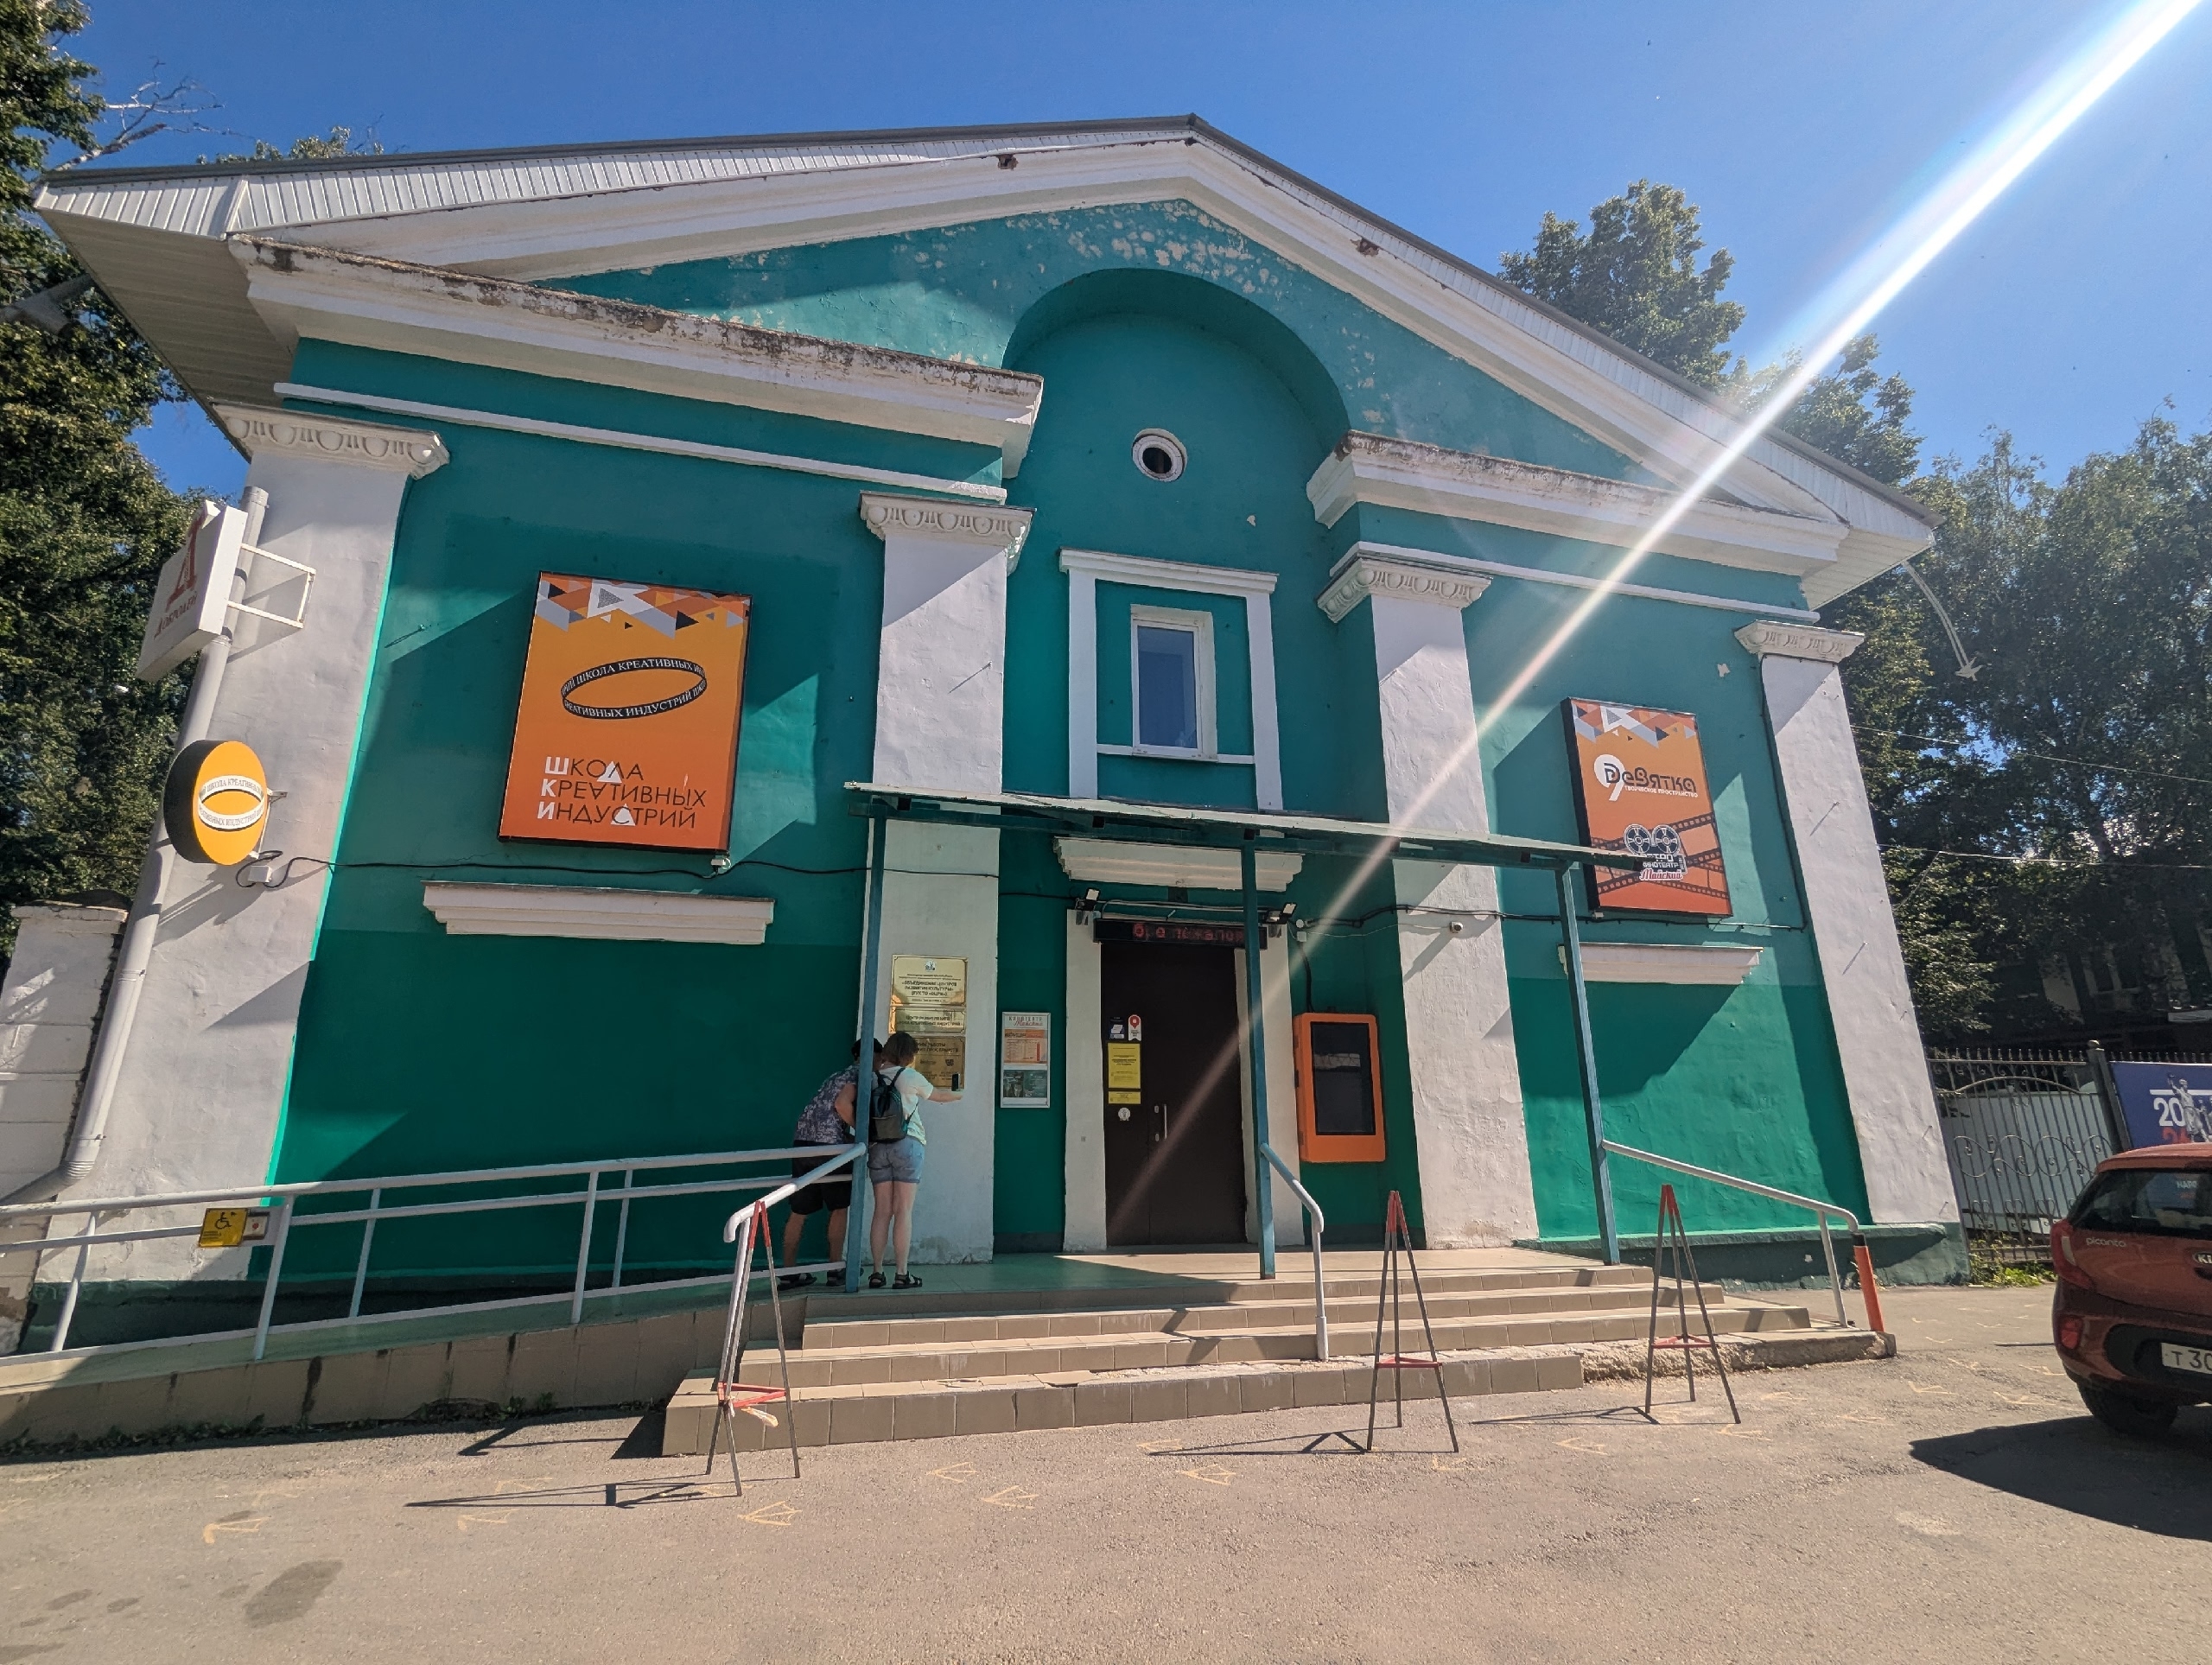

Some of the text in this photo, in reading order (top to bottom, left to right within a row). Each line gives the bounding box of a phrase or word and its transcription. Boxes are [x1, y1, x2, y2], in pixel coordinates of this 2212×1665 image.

[576, 664, 616, 685] ШКОЛА
[618, 658, 693, 670] КРЕАТИВНЫХ
[626, 690, 692, 715] ИНДУСТРИЙ
[544, 756, 645, 781] ШКОЛА
[541, 778, 707, 807] КРЕАТИВНЫХ
[1624, 785, 1699, 798] ТВОРЧЕСКОЕ ПРОСТРАНСТВО
[537, 801, 696, 829] ИНДУСТРИЙ
[1640, 867, 1683, 880] Майский
[2153, 1096, 2187, 1127] 20
[2086, 1236, 2126, 1248] picanto
